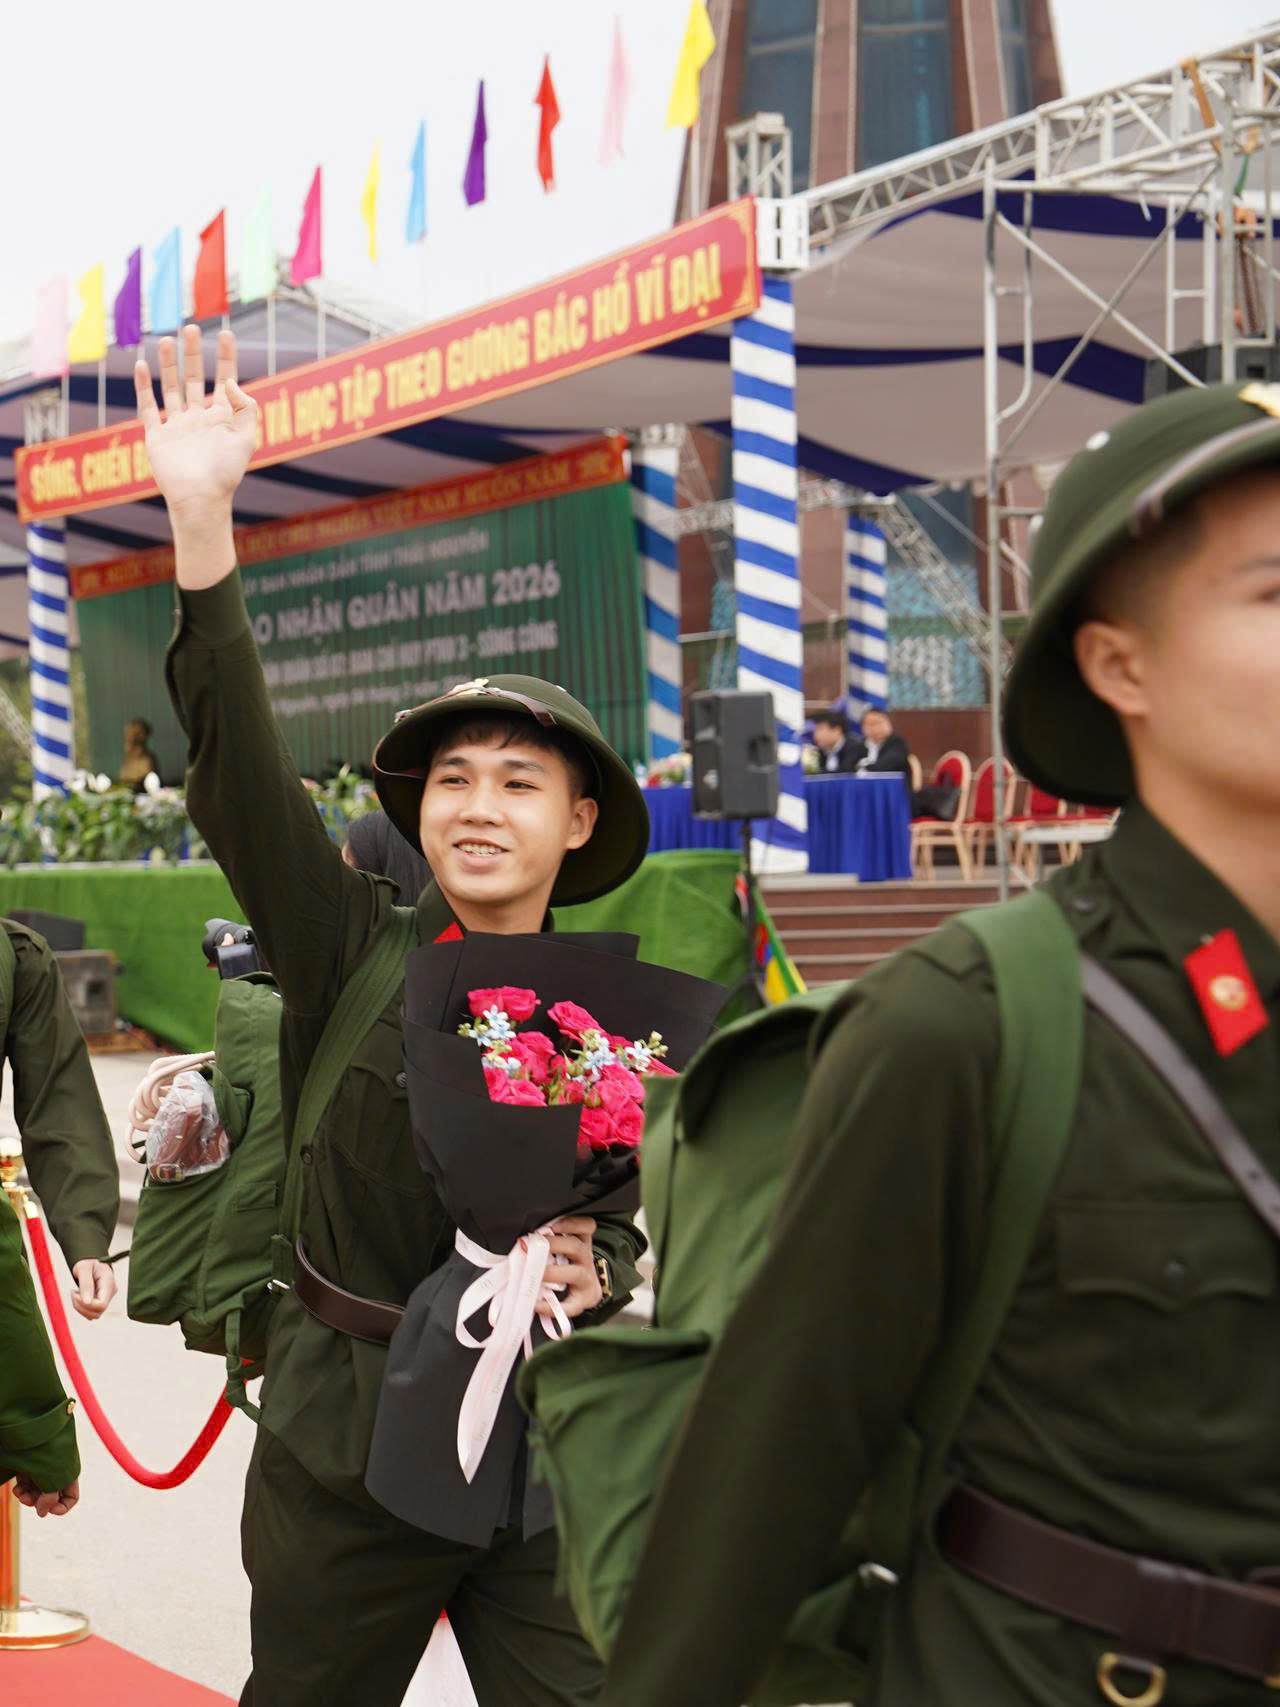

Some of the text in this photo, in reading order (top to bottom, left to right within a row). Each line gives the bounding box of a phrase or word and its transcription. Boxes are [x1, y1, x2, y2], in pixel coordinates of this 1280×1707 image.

[264, 386, 293, 446] VÀ
[294, 381, 337, 443] HỌC
[339, 363, 382, 430] TẬP
[384, 347, 442, 410] THEO
[446, 317, 530, 392] GƯƠNG
[534, 290, 588, 364] BÁC
[592, 260, 631, 343] HỒ
[635, 253, 666, 325] VĨ
[670, 241, 722, 318] ĐẠI
[277, 595, 343, 643] NHẬN
[347, 579, 418, 629] QUÂN
[424, 569, 486, 617] NĂM
[492, 559, 561, 606] 2026
